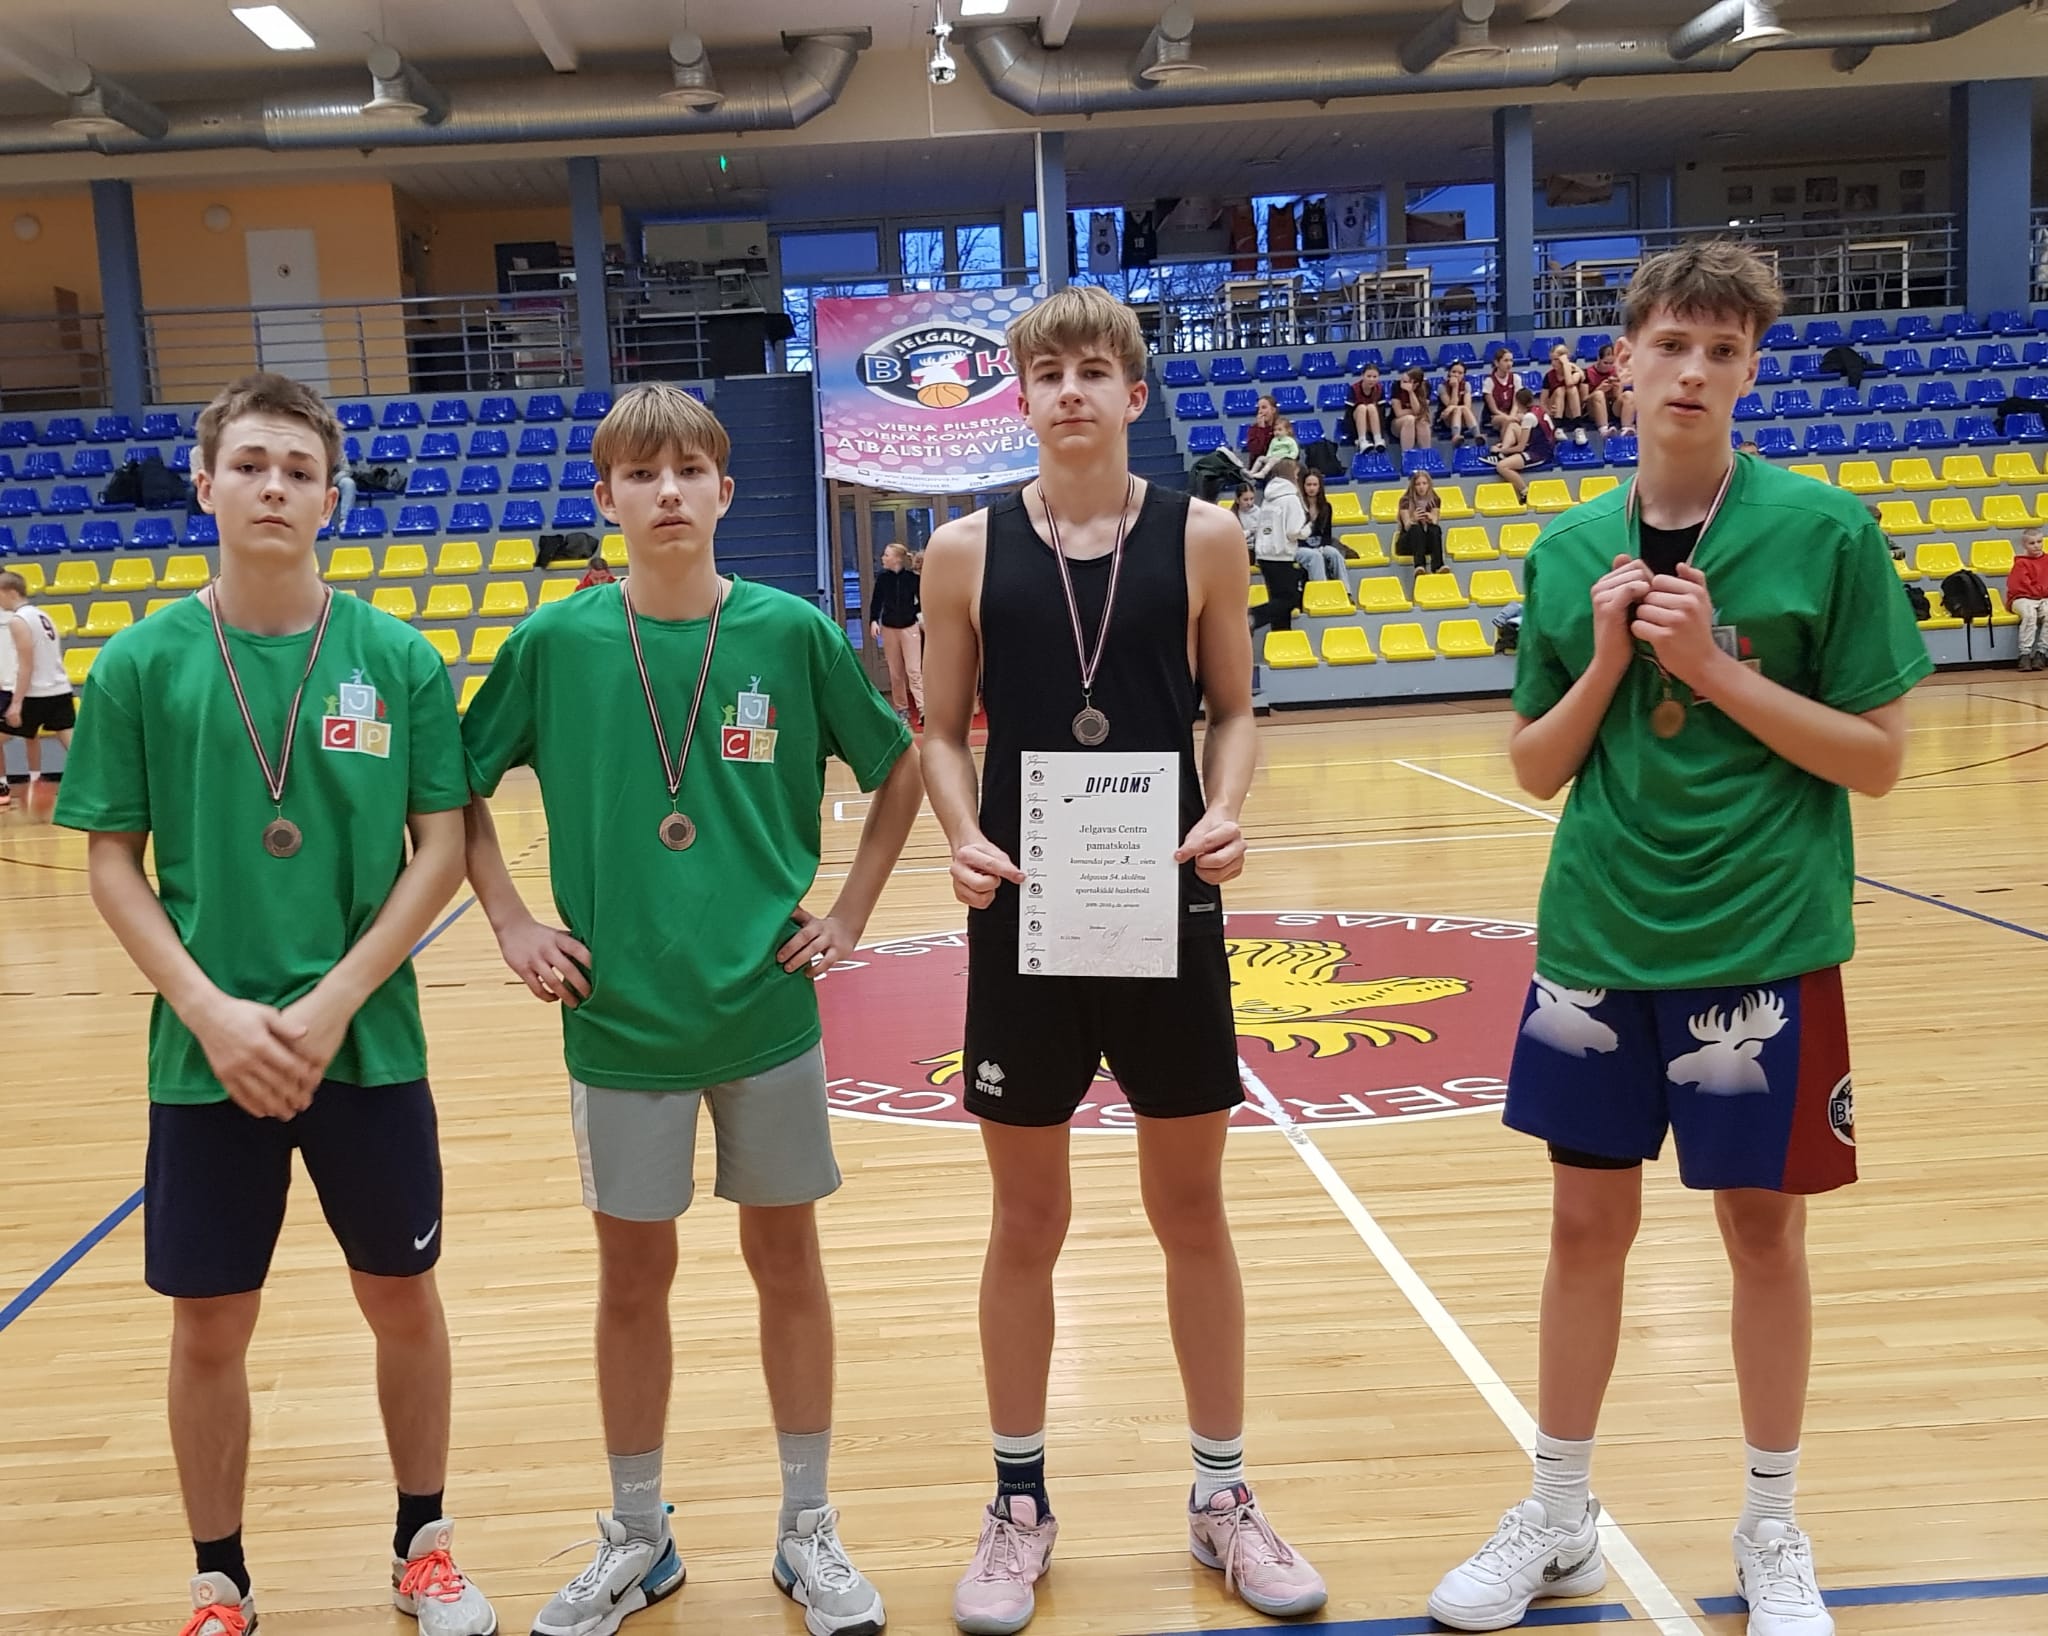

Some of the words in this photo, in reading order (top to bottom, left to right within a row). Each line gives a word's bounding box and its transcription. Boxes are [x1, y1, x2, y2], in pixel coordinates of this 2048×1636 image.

[895, 331, 977, 353] JELGAVA
[864, 354, 902, 384] B
[975, 348, 1016, 377] K
[859, 430, 921, 442] VIENA
[877, 423, 937, 432] VIENA
[837, 437, 941, 457] ATBALSTI
[38, 614, 55, 641] 9
[348, 690, 368, 711] J
[745, 699, 763, 720] J
[330, 723, 351, 745] C
[367, 728, 382, 749] P
[726, 733, 745, 755] C
[757, 734, 770, 756] P
[1085, 777, 1151, 793] DIPLOMS
[1079, 825, 1116, 835] Jelgavas
[1118, 825, 1147, 833] Centra
[1086, 841, 1141, 852] pamatskolas
[975, 1079, 1003, 1097] errea
